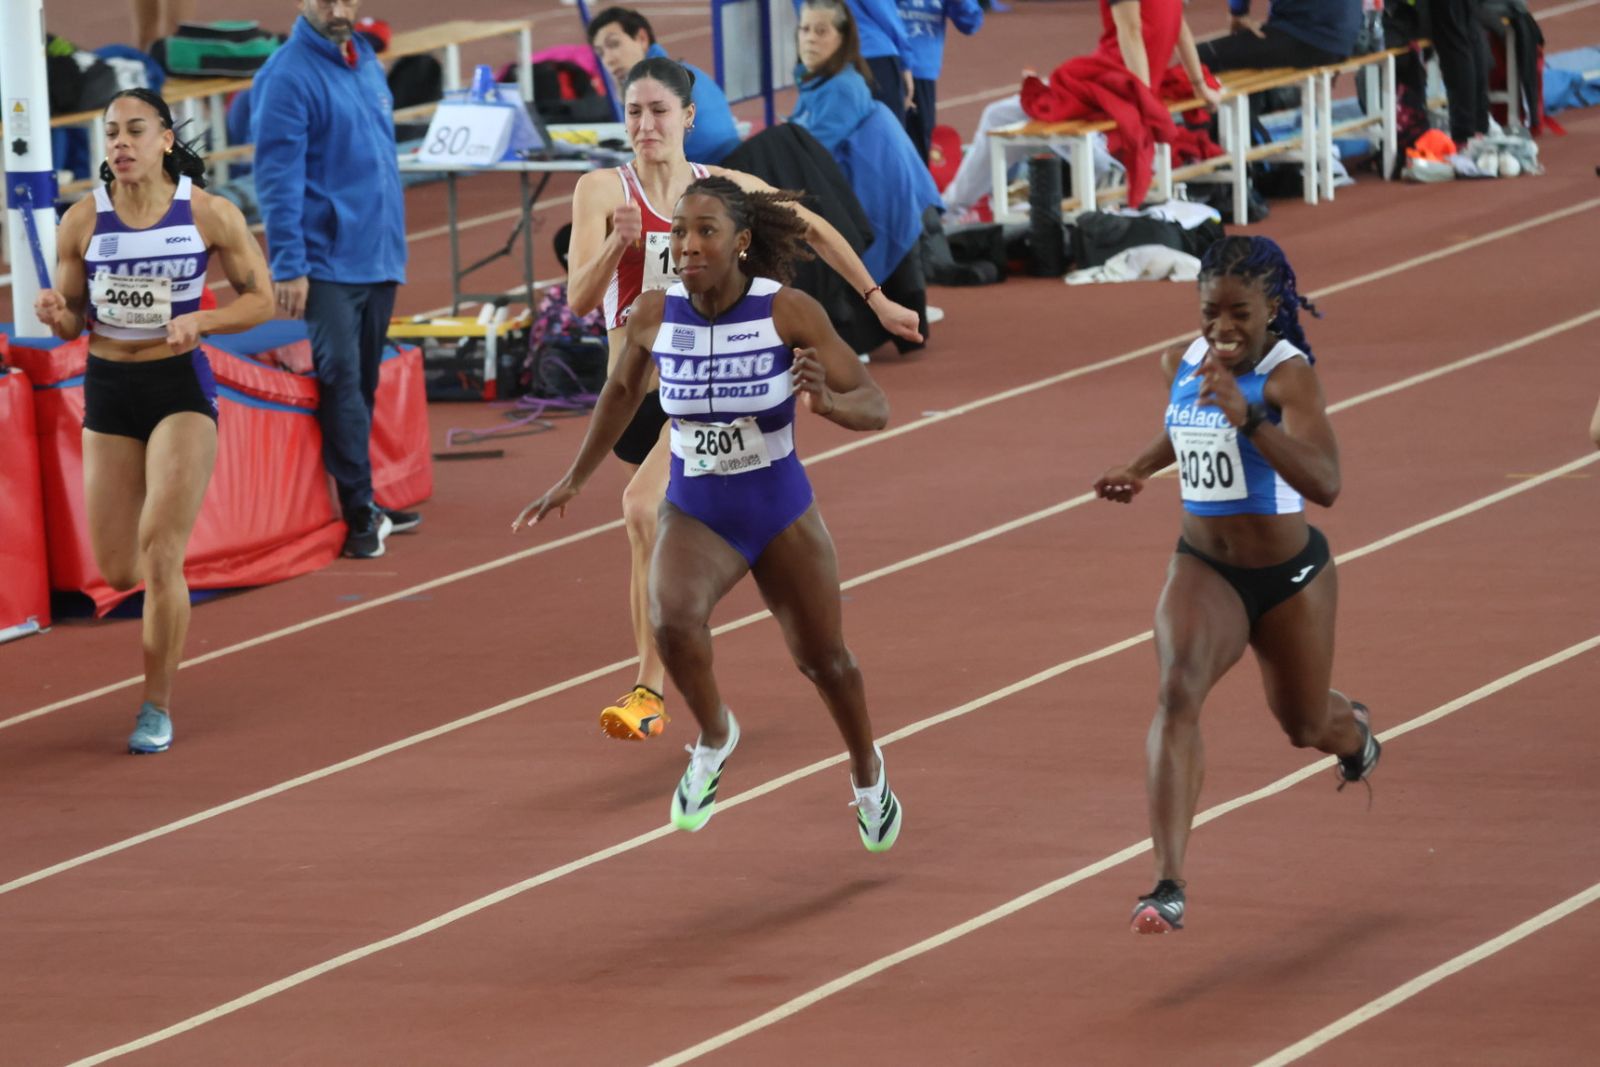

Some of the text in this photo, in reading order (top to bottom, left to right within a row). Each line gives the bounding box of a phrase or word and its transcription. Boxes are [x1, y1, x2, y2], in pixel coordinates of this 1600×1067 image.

[428, 126, 470, 155] 80
[96, 257, 198, 279] RACING
[105, 288, 154, 308] 2600
[674, 328, 695, 336] RACING
[659, 352, 775, 381] RACING
[661, 383, 769, 400] VALLADOLID
[695, 428, 745, 456] 2601
[1181, 450, 1234, 489] 4030
